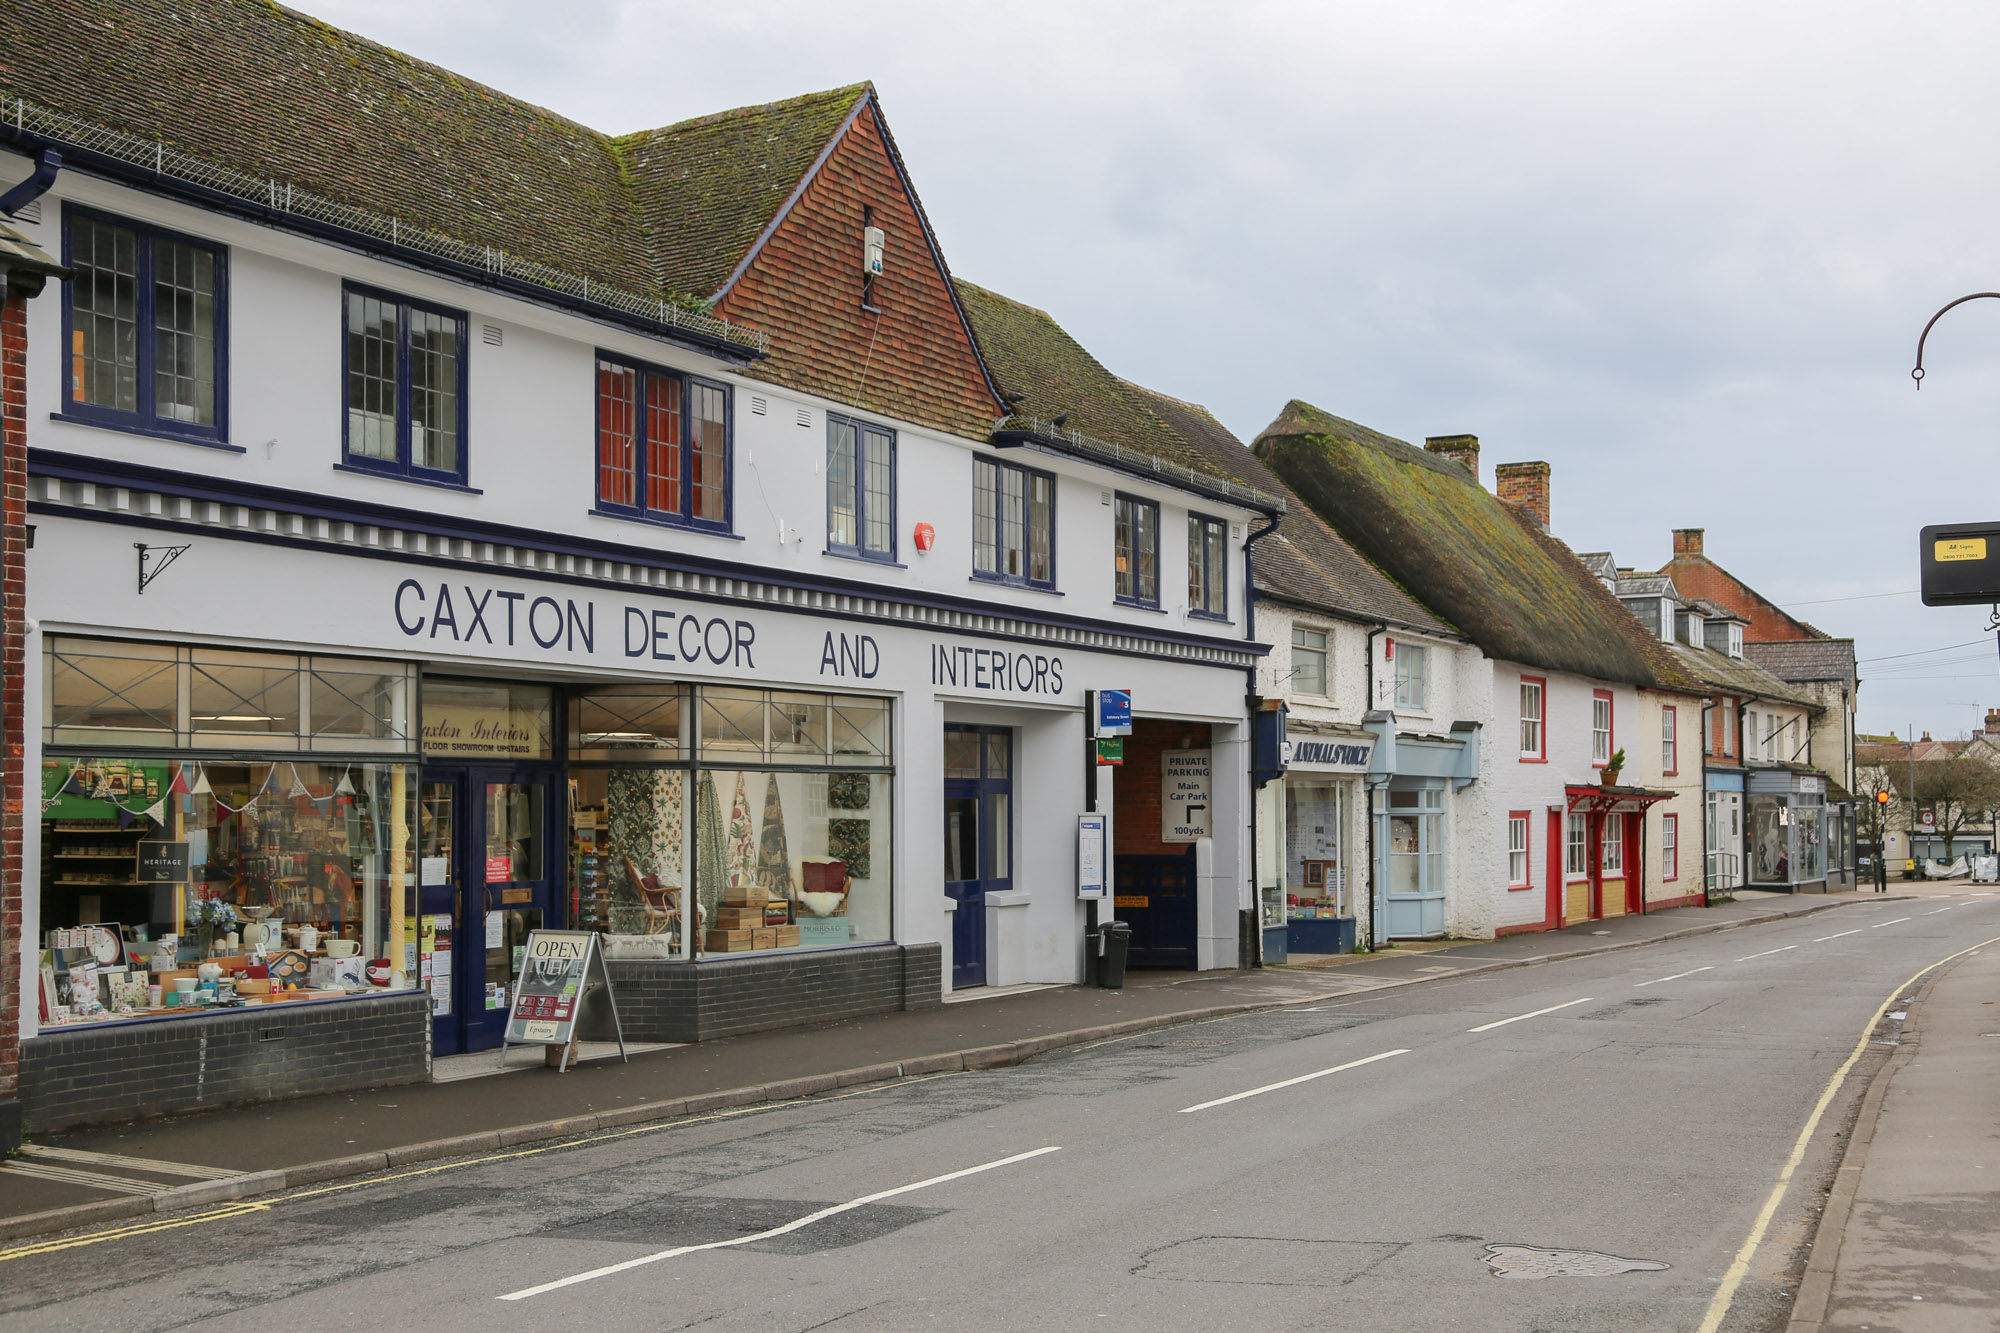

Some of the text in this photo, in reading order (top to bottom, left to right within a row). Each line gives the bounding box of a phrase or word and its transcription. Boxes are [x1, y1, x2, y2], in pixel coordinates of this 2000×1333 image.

[395, 578, 1063, 695] CAXTON DECOR AND INTERIORS
[421, 718, 530, 742] axton Interiors
[423, 742, 530, 753] FLOOR SHOWROOM UPSTAIRS
[1169, 757, 1208, 766] PRIVATE
[1167, 768, 1210, 776] PARKING
[1177, 782, 1200, 790] Main
[1169, 792, 1208, 801] Car Park
[1174, 826, 1205, 836] 100yds
[536, 941, 583, 958] OPEN
[529, 1025, 552, 1034] Upstairs
